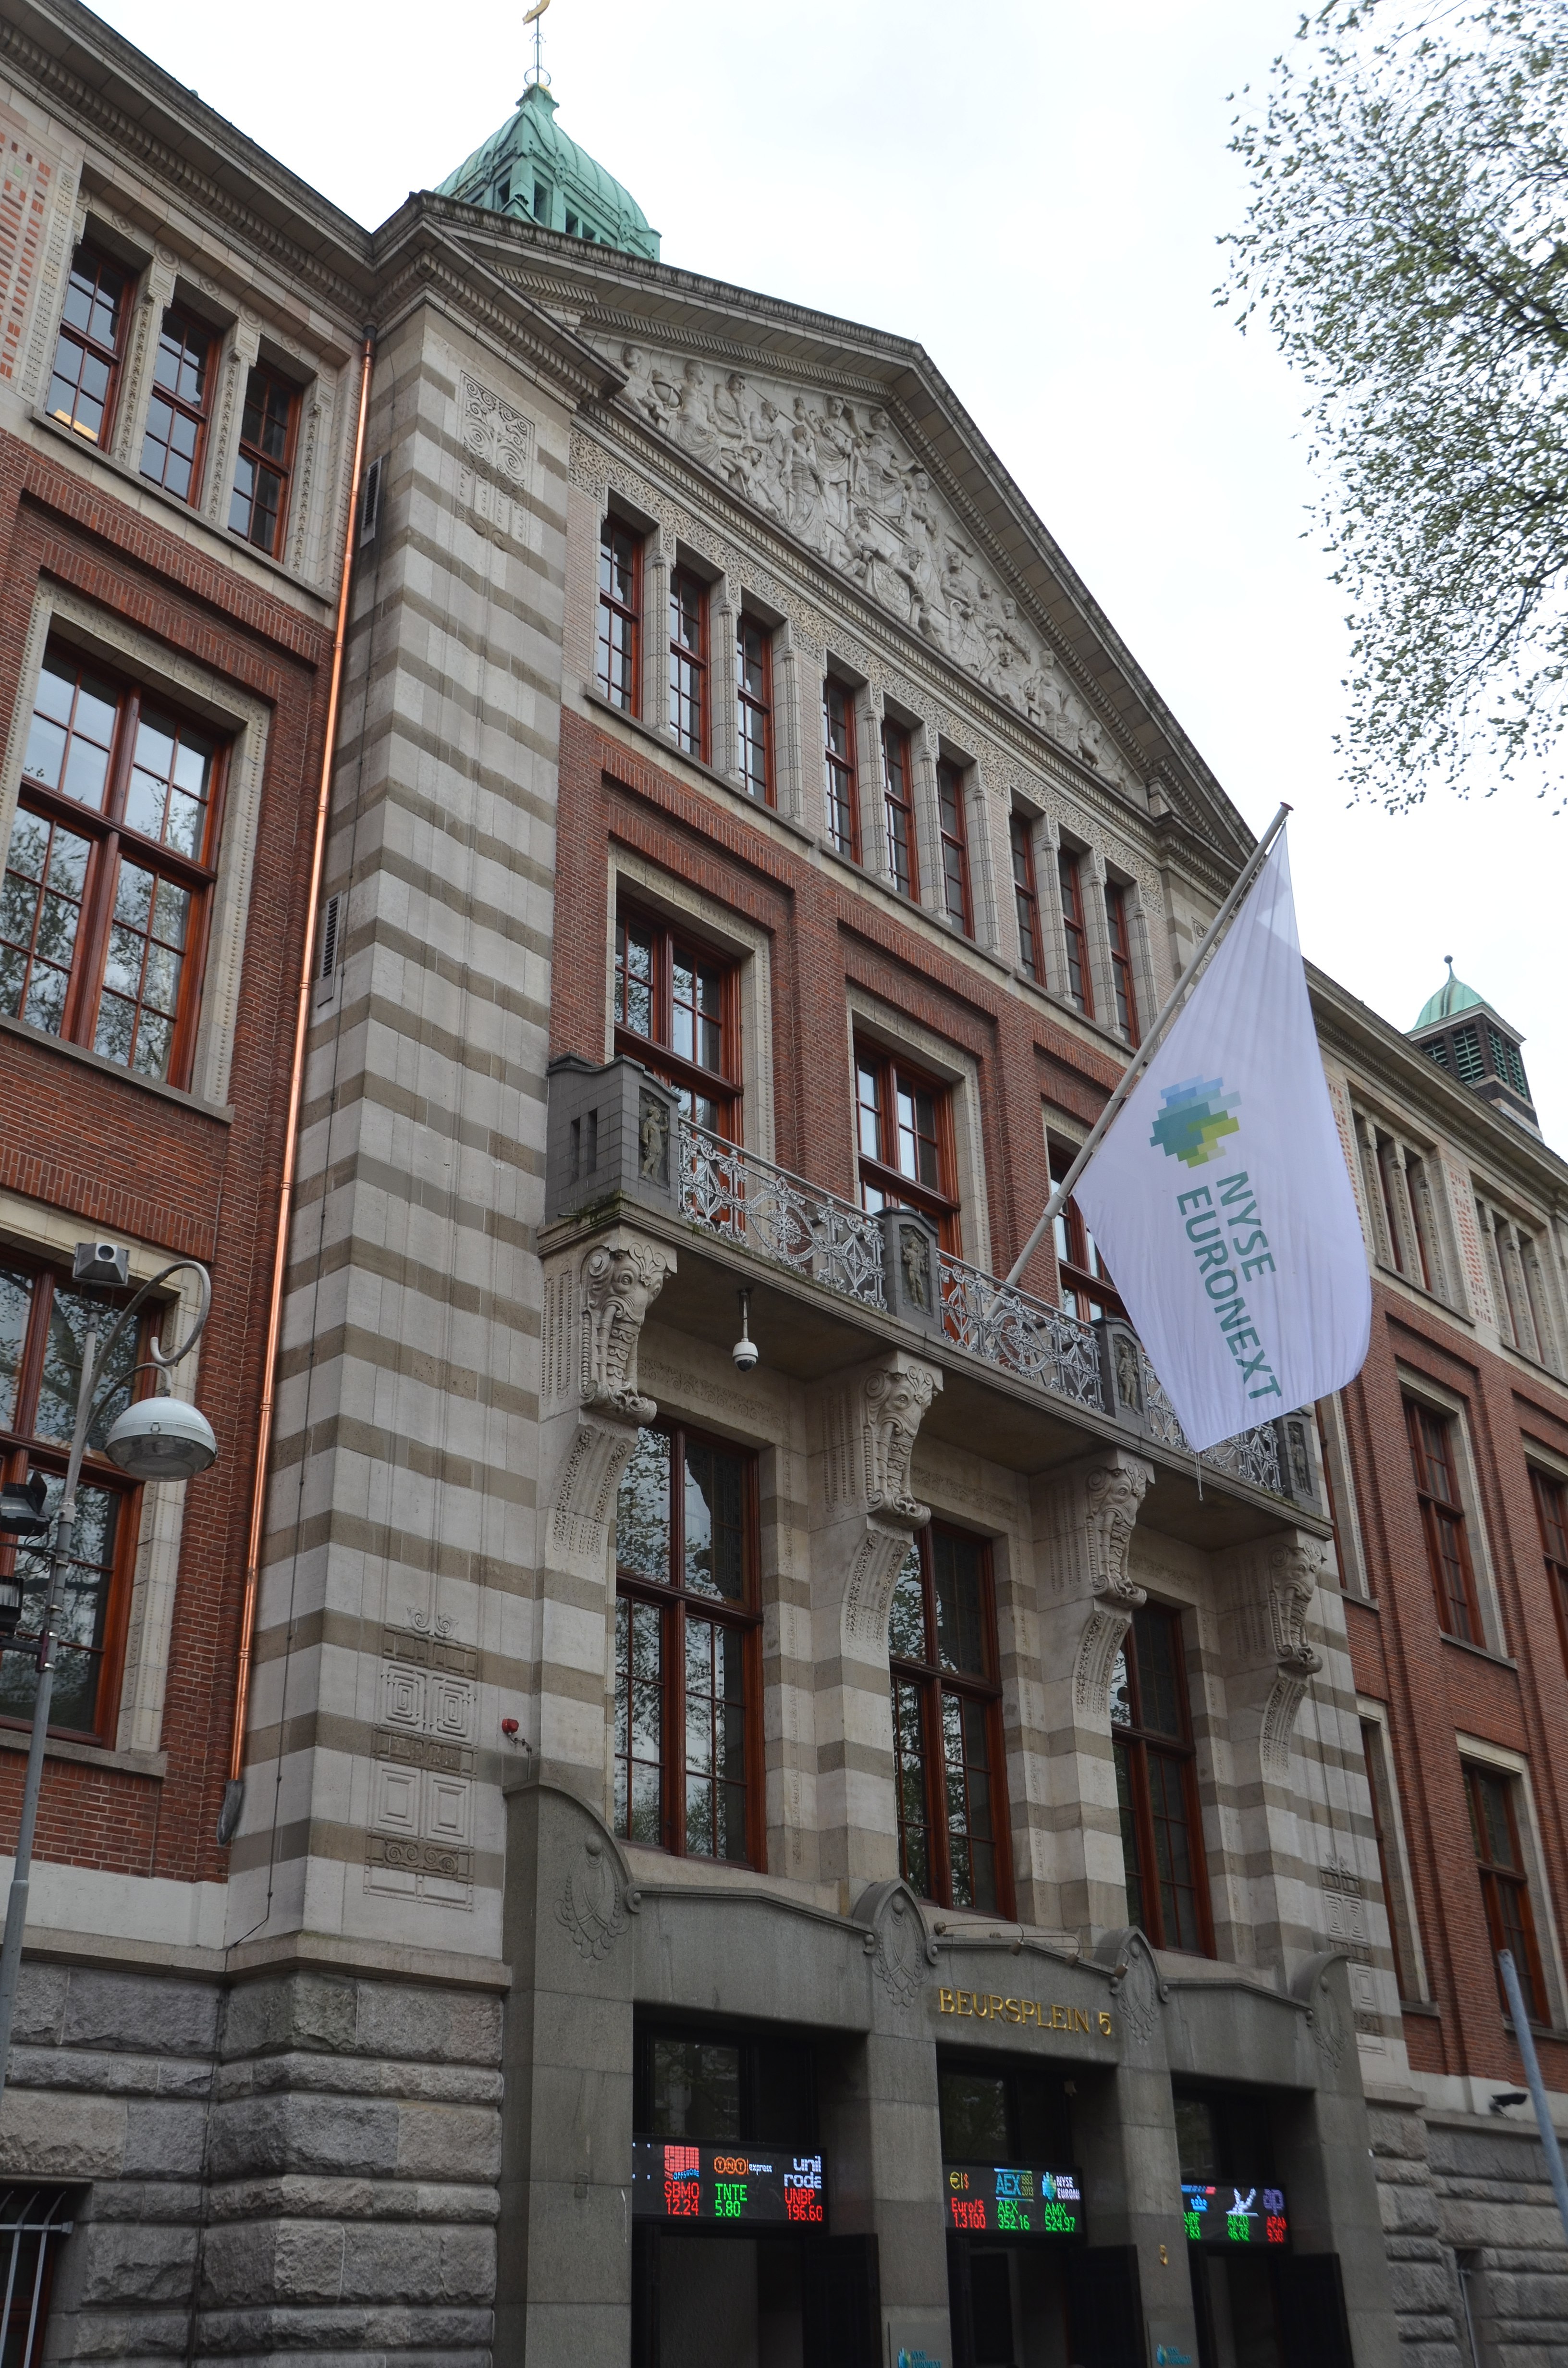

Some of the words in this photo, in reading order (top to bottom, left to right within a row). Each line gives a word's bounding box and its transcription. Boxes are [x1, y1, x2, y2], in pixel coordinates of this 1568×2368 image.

[1216, 1171, 1276, 1282] NYSE
[1176, 1185, 1282, 1399] EURONEXT
[939, 1987, 1089, 2033] BEURSPLEIN
[1099, 2012, 1112, 2035] 5
[673, 2168, 699, 2181] OFFSHORE
[714, 2156, 747, 2175] TNT
[749, 2163, 772, 2176] express
[664, 2181, 699, 2199] SBMO
[995, 2173, 1022, 2195] AEX
[1056, 2176, 1074, 2188] NYSE
[715, 2183, 747, 2201] TNTE
[784, 2188, 815, 2205] UNBP
[666, 2198, 698, 2216] 12.24
[715, 2200, 741, 2217] 5.80
[787, 2204, 822, 2221] 196.60
[998, 2200, 1019, 2215] AEX
[1045, 2202, 1067, 2217] AMX
[954, 2213, 986, 2229] 1.3100
[998, 2214, 1030, 2231] 352.16
[1045, 2216, 1076, 2232] 524.97
[1159, 2245, 1168, 2266] 5
